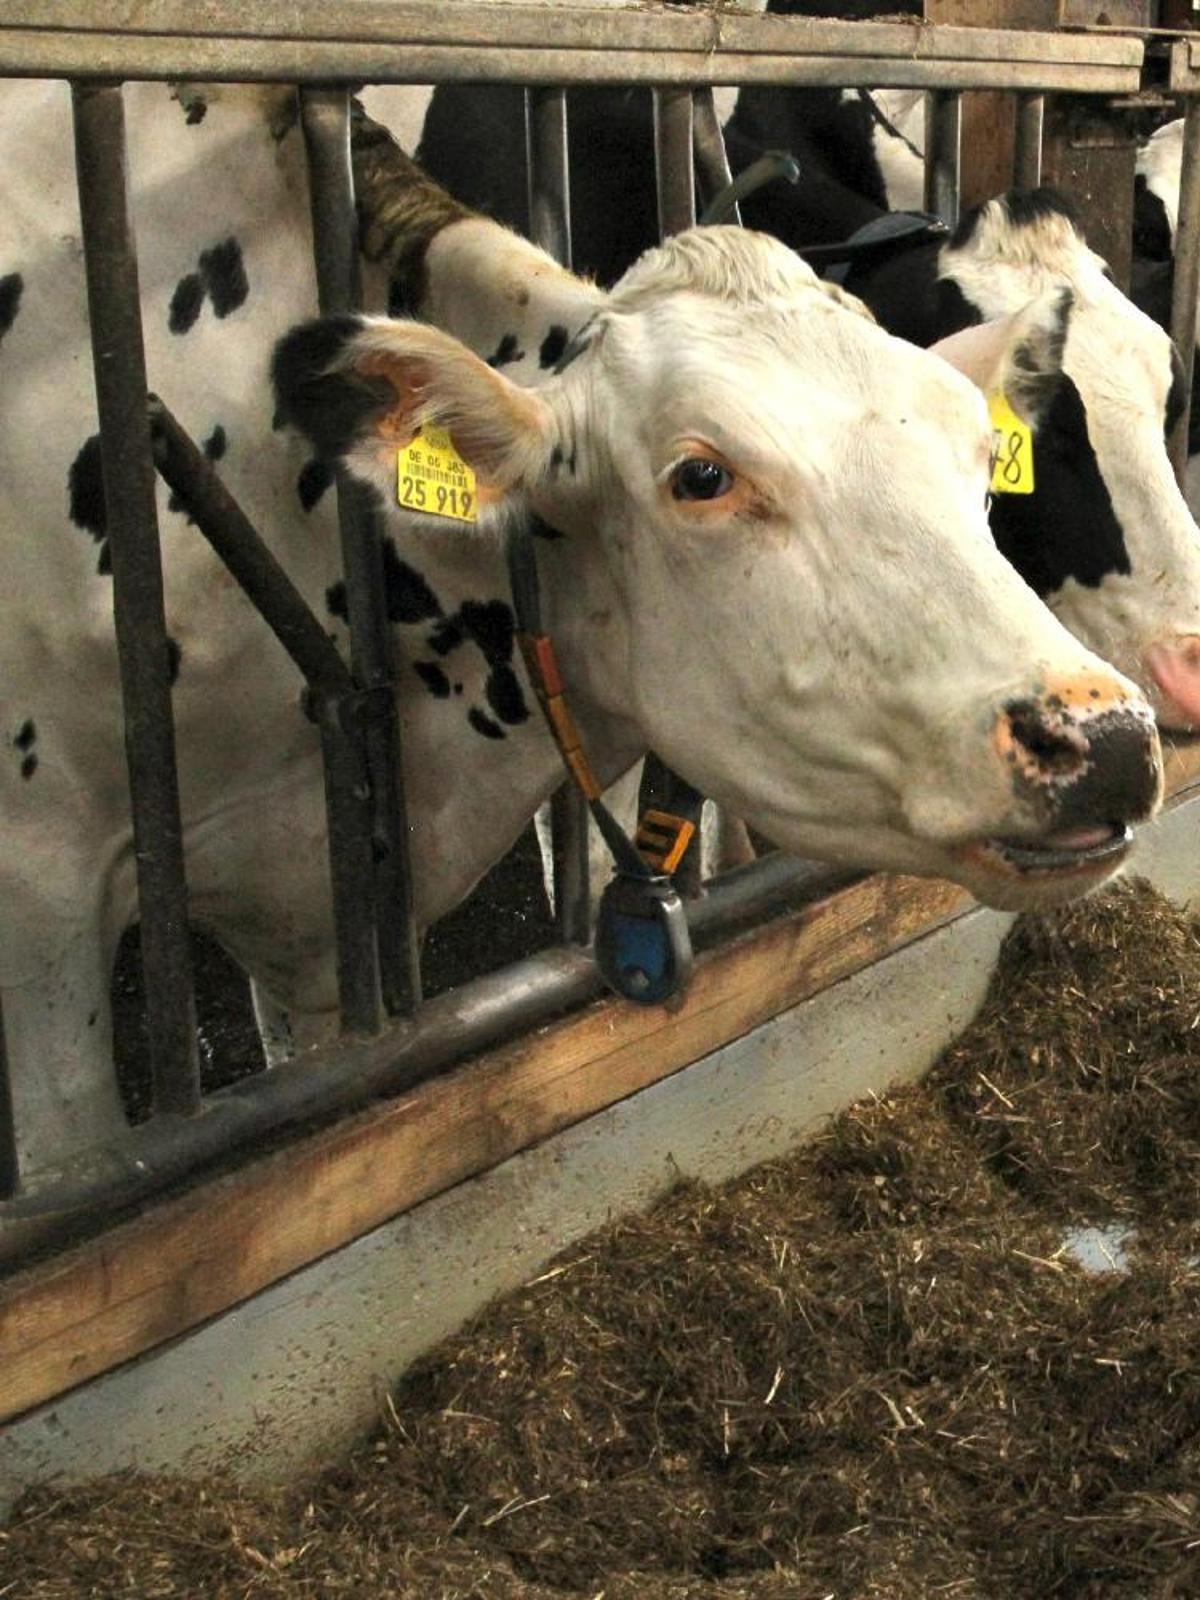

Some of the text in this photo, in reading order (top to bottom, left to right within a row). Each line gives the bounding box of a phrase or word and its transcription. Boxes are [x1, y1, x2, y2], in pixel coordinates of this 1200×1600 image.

[409, 449, 422, 463] DE
[402, 476, 472, 517] 25 919
